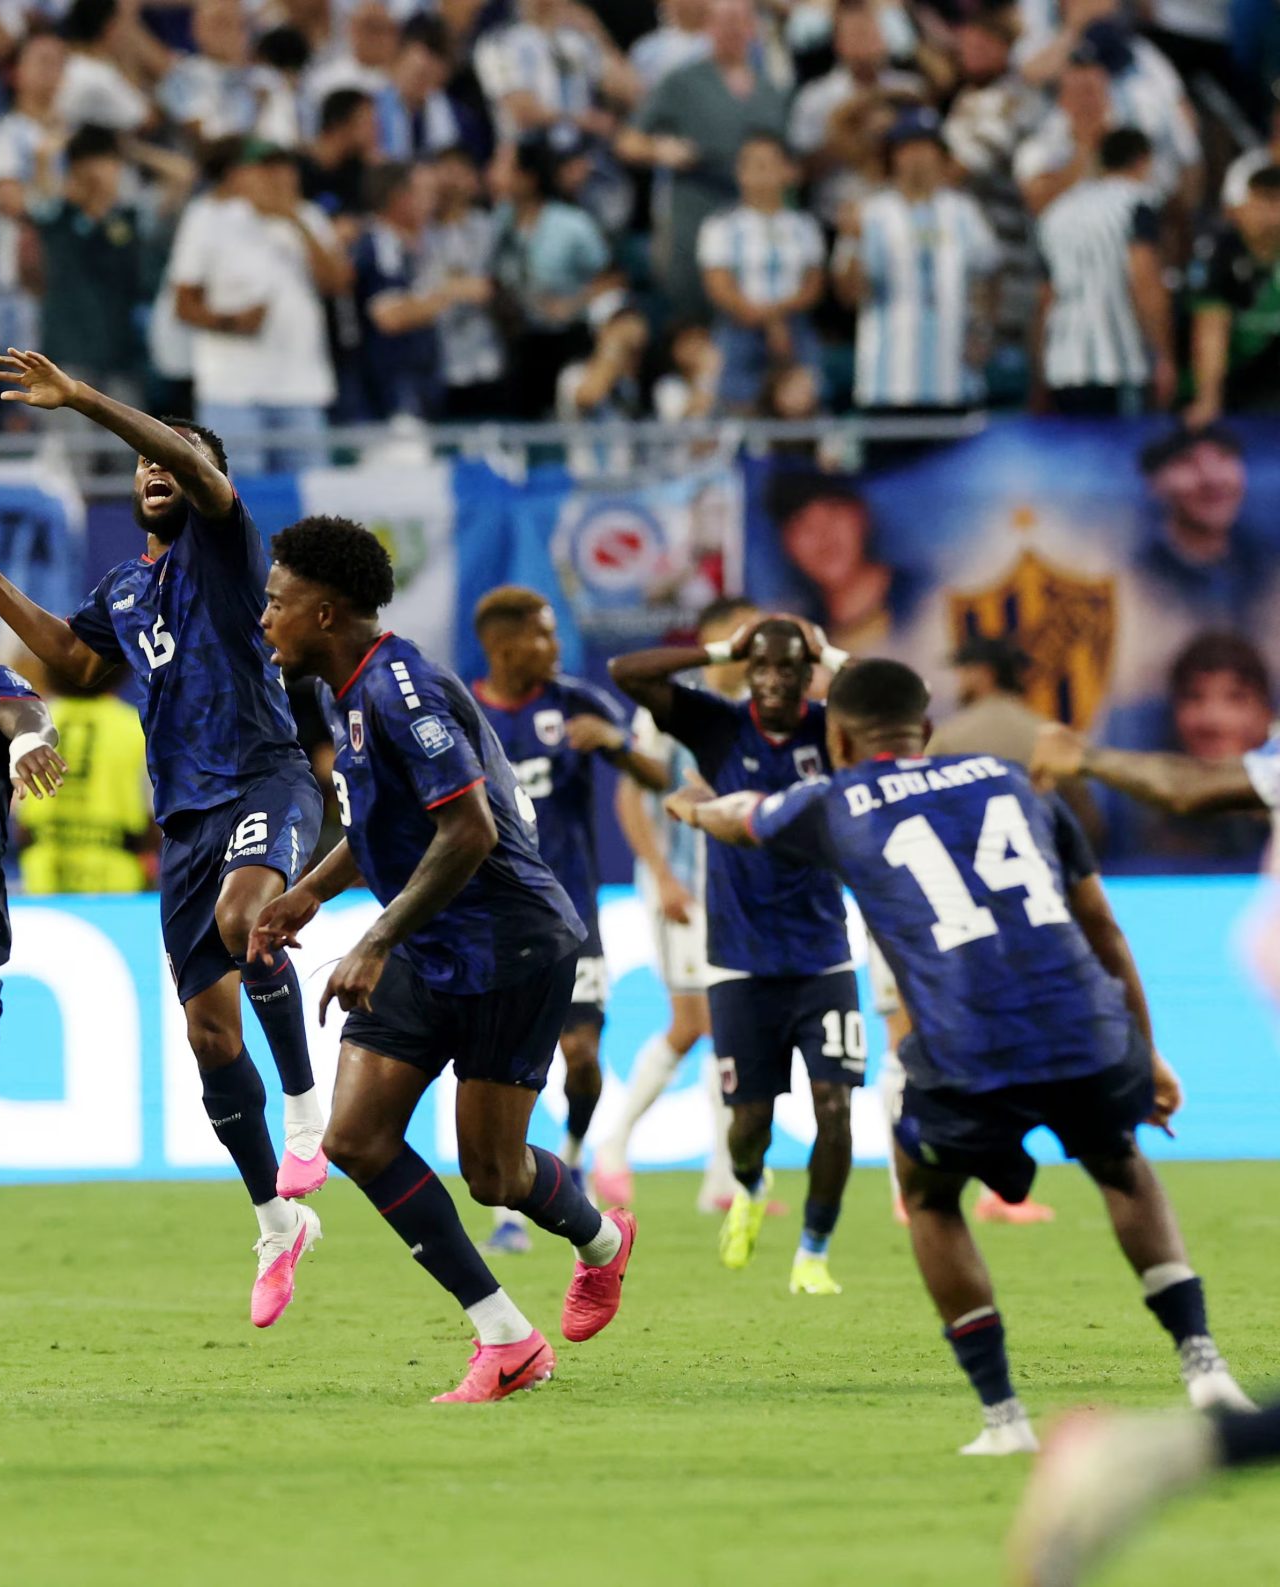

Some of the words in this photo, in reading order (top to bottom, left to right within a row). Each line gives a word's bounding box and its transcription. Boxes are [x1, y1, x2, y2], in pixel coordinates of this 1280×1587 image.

[844, 783, 882, 817] D.
[877, 756, 1009, 803] DUARTE
[882, 794, 1070, 952] 14
[821, 1010, 868, 1060] 10
